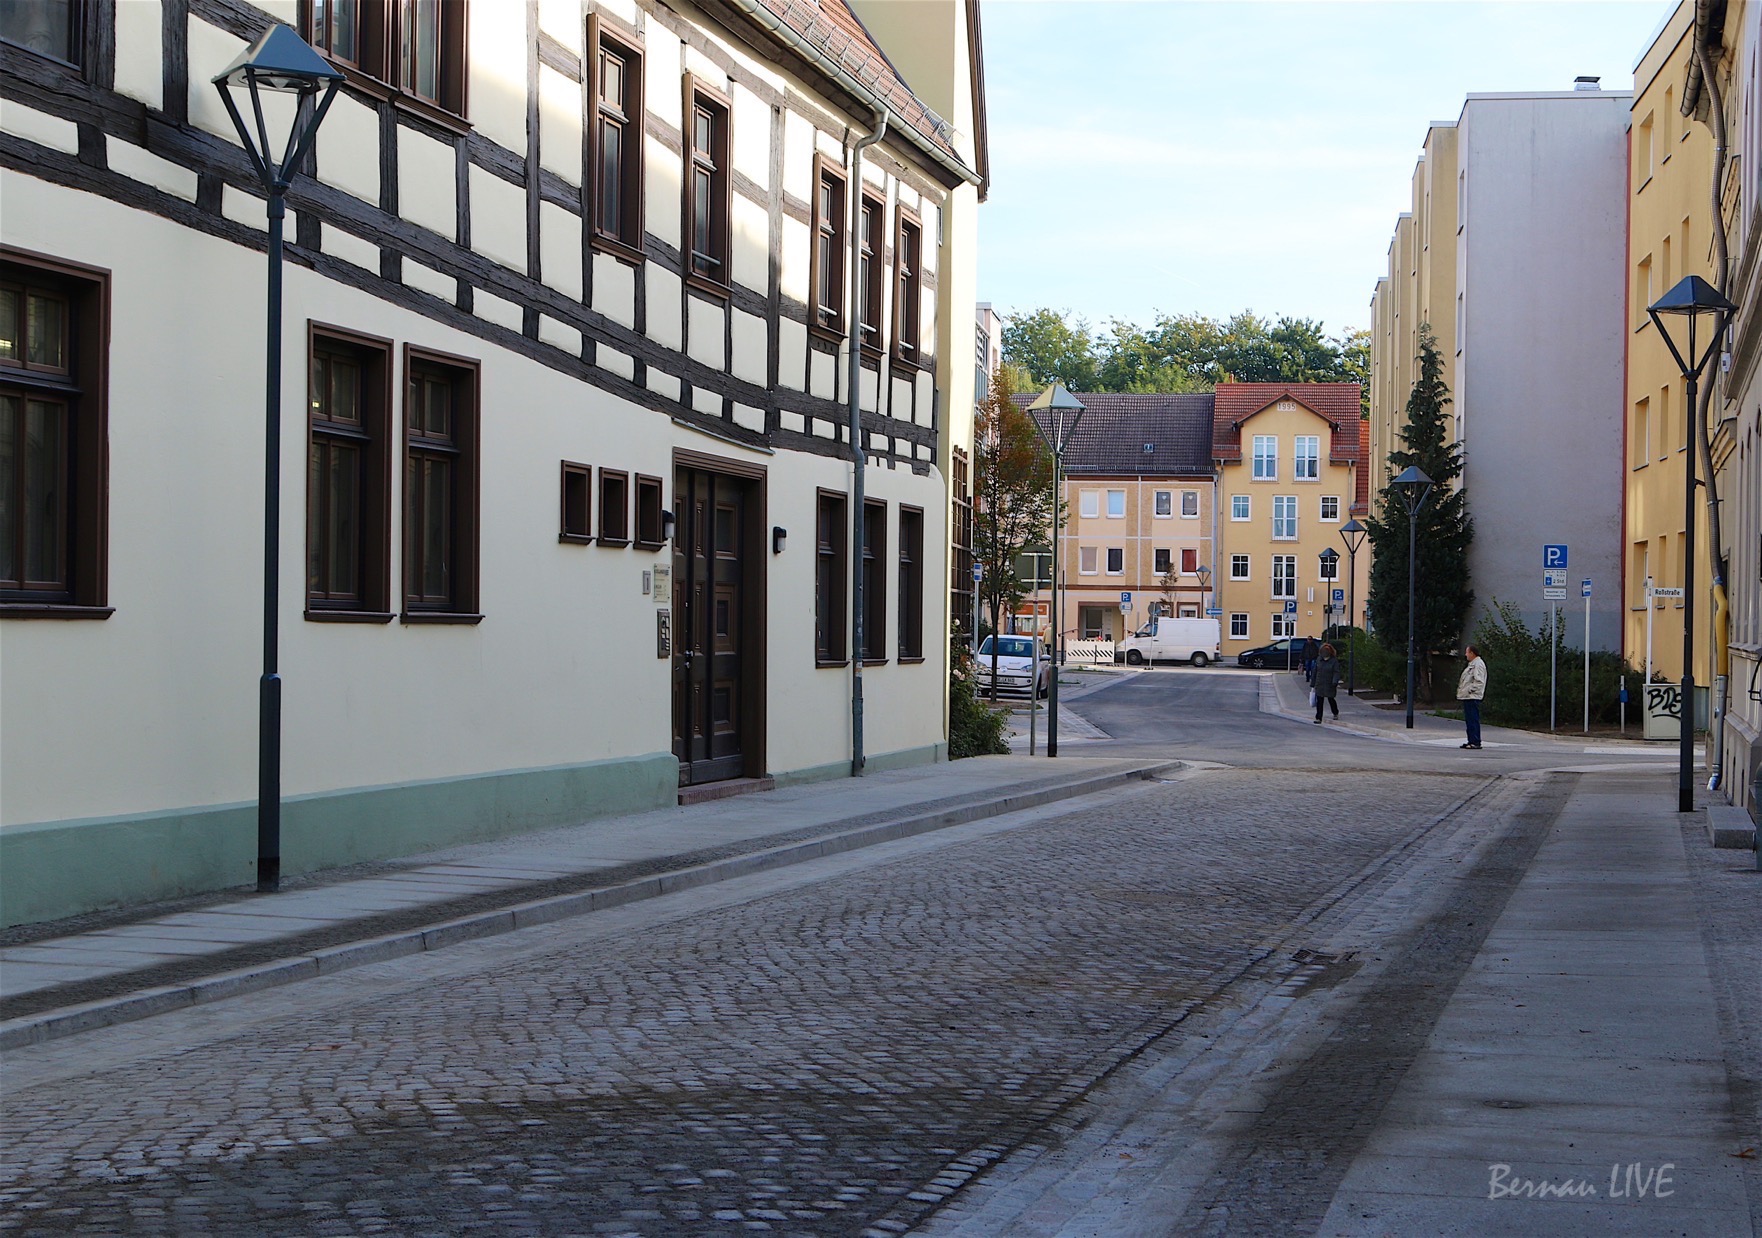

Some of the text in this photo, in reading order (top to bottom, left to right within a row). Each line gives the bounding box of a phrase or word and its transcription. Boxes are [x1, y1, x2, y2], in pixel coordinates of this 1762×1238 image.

[1278, 402, 1296, 410] 1995
[1547, 547, 1561, 566] P
[1334, 590, 1341, 599] P
[1655, 588, 1680, 596] Roßstraße
[1122, 593, 1129, 601] P
[1287, 601, 1295, 613] P
